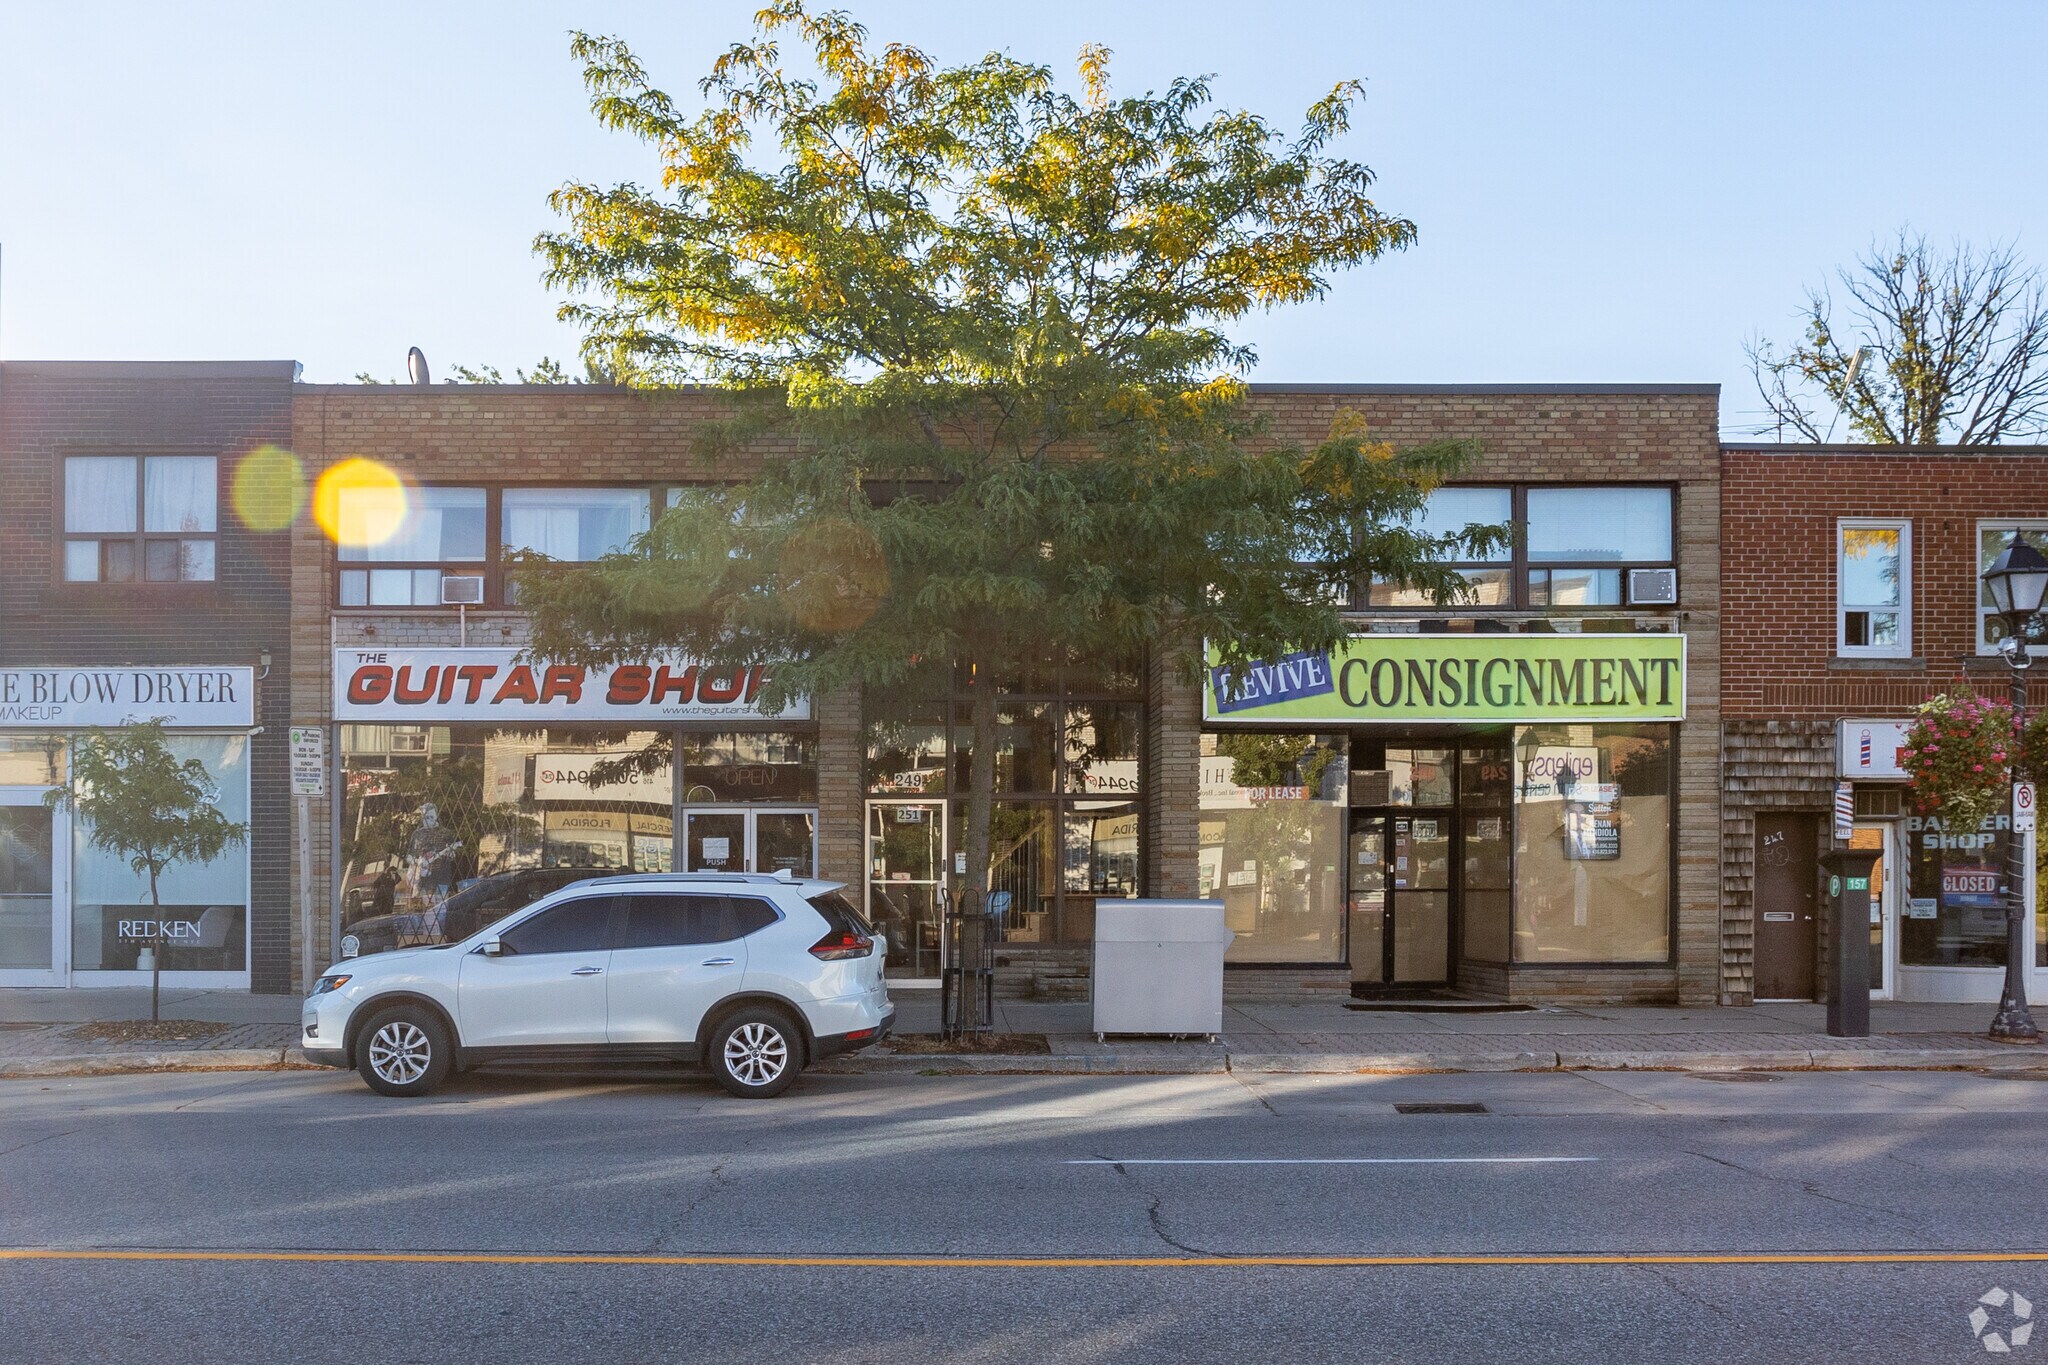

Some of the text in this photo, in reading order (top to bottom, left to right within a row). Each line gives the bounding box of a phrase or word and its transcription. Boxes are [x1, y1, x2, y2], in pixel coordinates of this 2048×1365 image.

[356, 653, 387, 663] THE
[29, 672, 124, 704] BLOW
[131, 672, 237, 704] DRYER
[346, 665, 586, 705] GUITAR
[1339, 657, 1679, 708] CONSIGNMENT
[662, 706, 765, 715] www.theguitarsho
[725, 769, 775, 786] OPEN
[895, 774, 922, 787] 249
[1245, 786, 1267, 800] FOR
[1268, 786, 1302, 800] LEASE
[899, 810, 919, 820] 251
[1592, 819, 1612, 828] ENAN
[1906, 814, 2011, 832] BAER
[1922, 833, 1996, 849] SHOP
[706, 858, 726, 866] PUSH
[1849, 878, 1865, 889] 157
[1942, 876, 1996, 892] CLOSED
[118, 920, 201, 938] REDKEN
